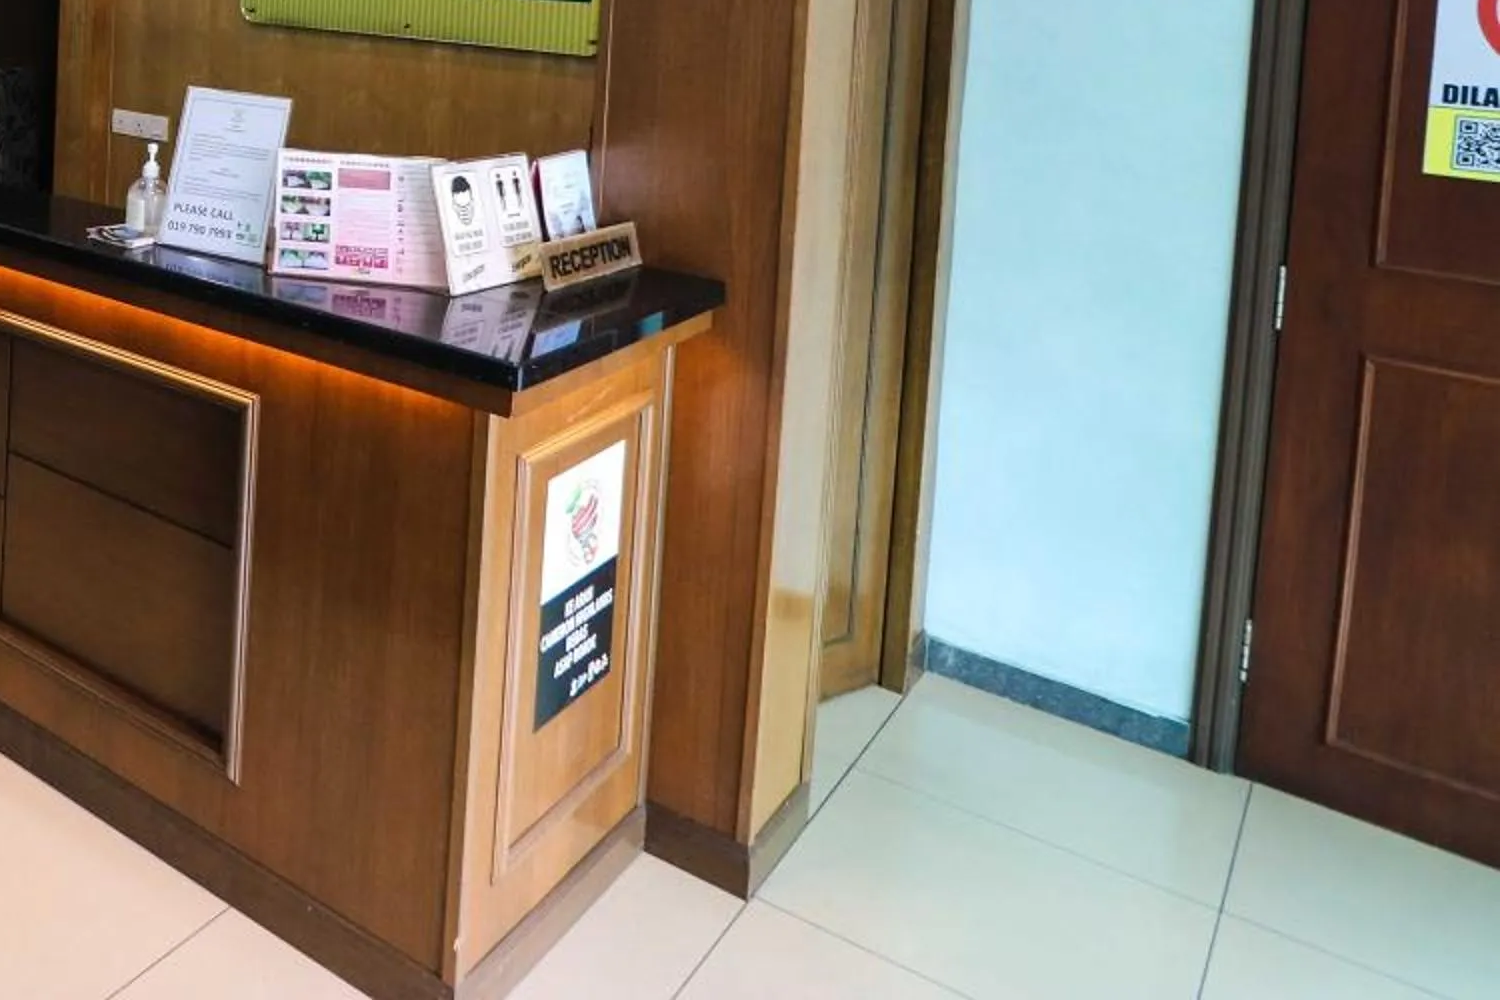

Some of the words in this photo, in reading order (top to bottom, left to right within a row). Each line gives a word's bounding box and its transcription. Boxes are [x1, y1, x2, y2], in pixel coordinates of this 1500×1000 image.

[173, 202, 208, 217] PLEASE
[209, 207, 233, 221] CALL
[550, 235, 632, 279] RECEPTION
